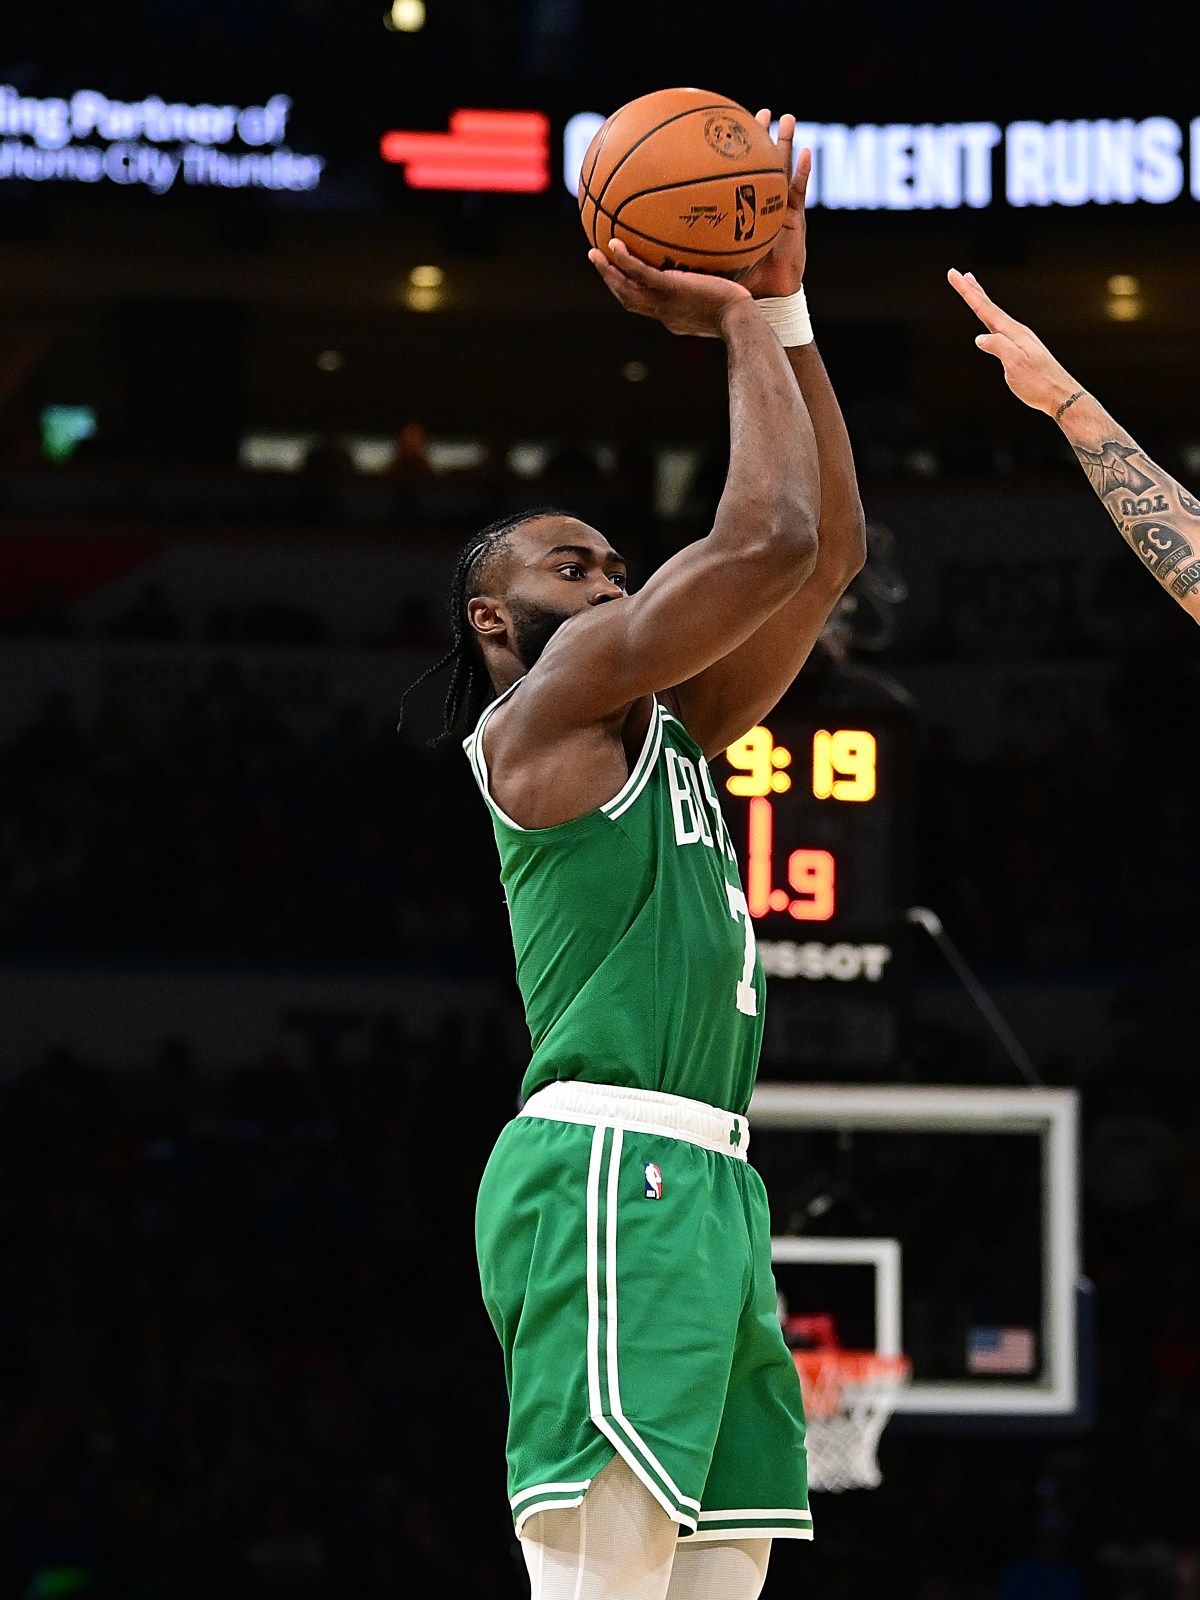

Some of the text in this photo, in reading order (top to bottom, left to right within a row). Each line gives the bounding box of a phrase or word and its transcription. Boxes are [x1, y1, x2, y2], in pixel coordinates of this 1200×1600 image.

[70, 89, 238, 143] Partner
[237, 93, 293, 146] of
[102, 140, 181, 194] City
[182, 143, 325, 191] Thunder
[564, 111, 1002, 210] CTMENT
[1005, 117, 1184, 206] RUNS
[1121, 494, 1170, 517] TCU
[1138, 527, 1172, 566] 35
[725, 877, 761, 1017] 7
